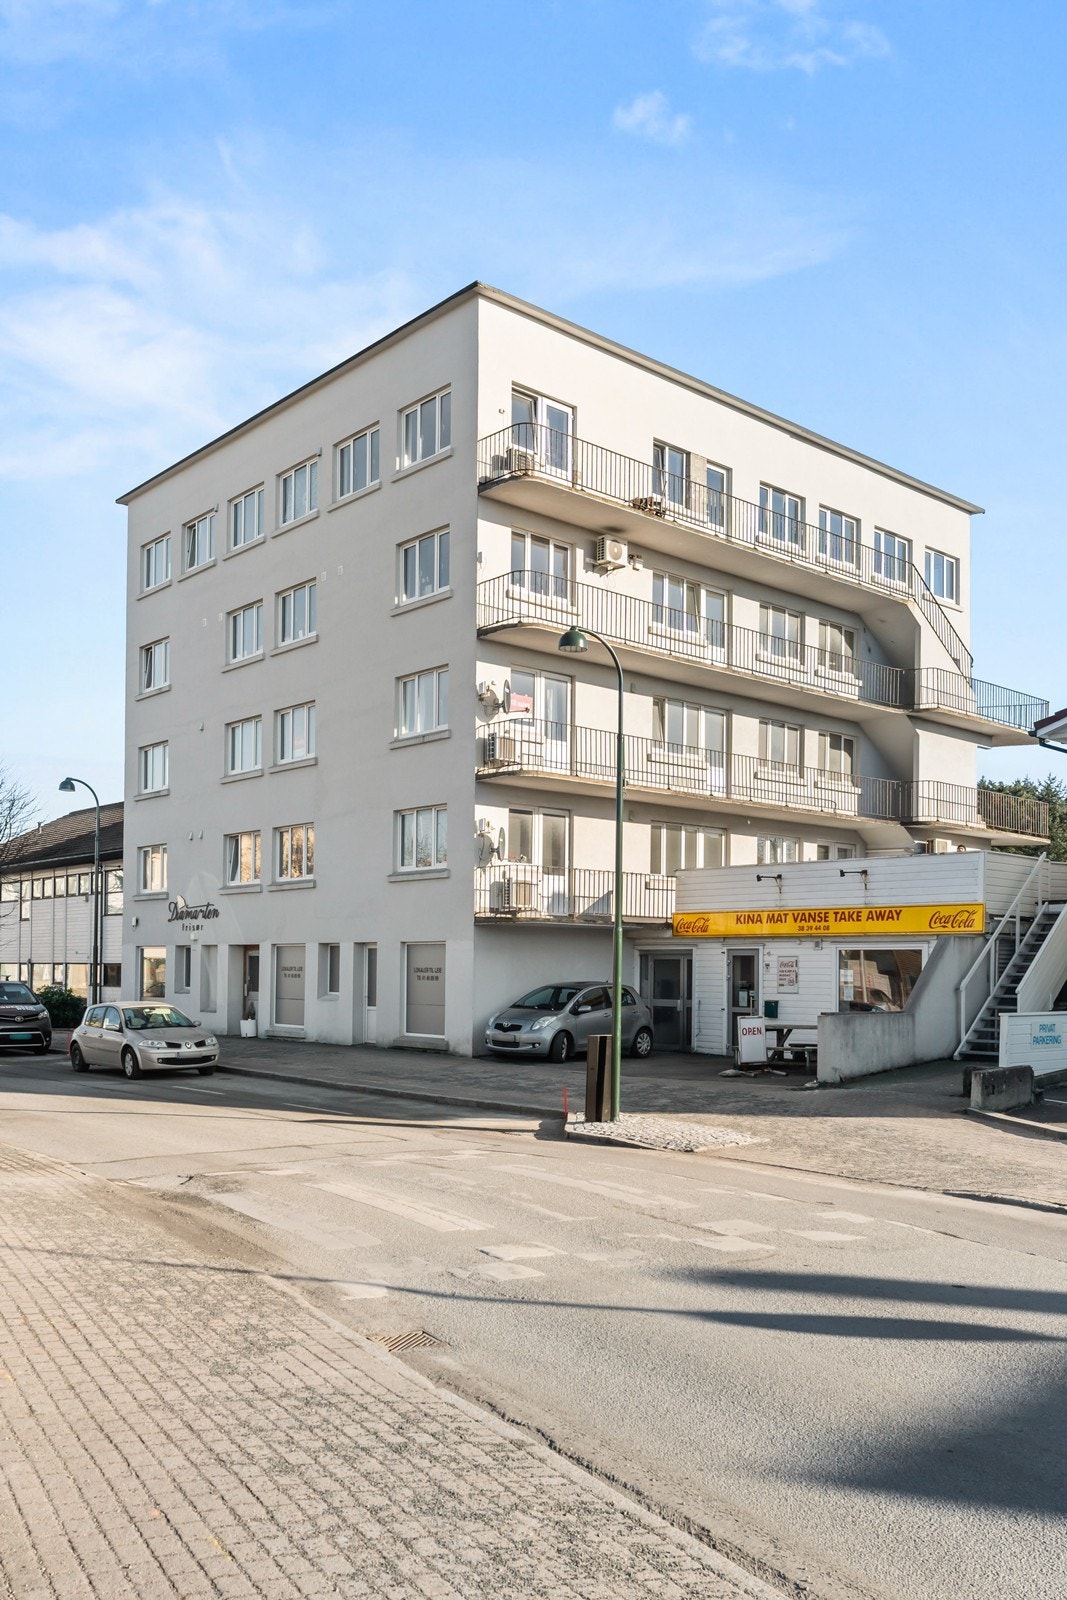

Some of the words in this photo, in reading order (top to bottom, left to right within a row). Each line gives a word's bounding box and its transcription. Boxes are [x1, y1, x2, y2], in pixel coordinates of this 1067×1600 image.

[736, 913, 763, 925] KINA
[766, 912, 789, 924] MAT
[792, 911, 830, 923] VANSE
[833, 910, 863, 922] TAKE
[866, 909, 902, 922] AWAY
[928, 909, 978, 929] Coca-Cola
[741, 1027, 762, 1036] OPEN
[1039, 1023, 1056, 1033] PRIVAT
[1032, 1035, 1062, 1045] PARKERING
